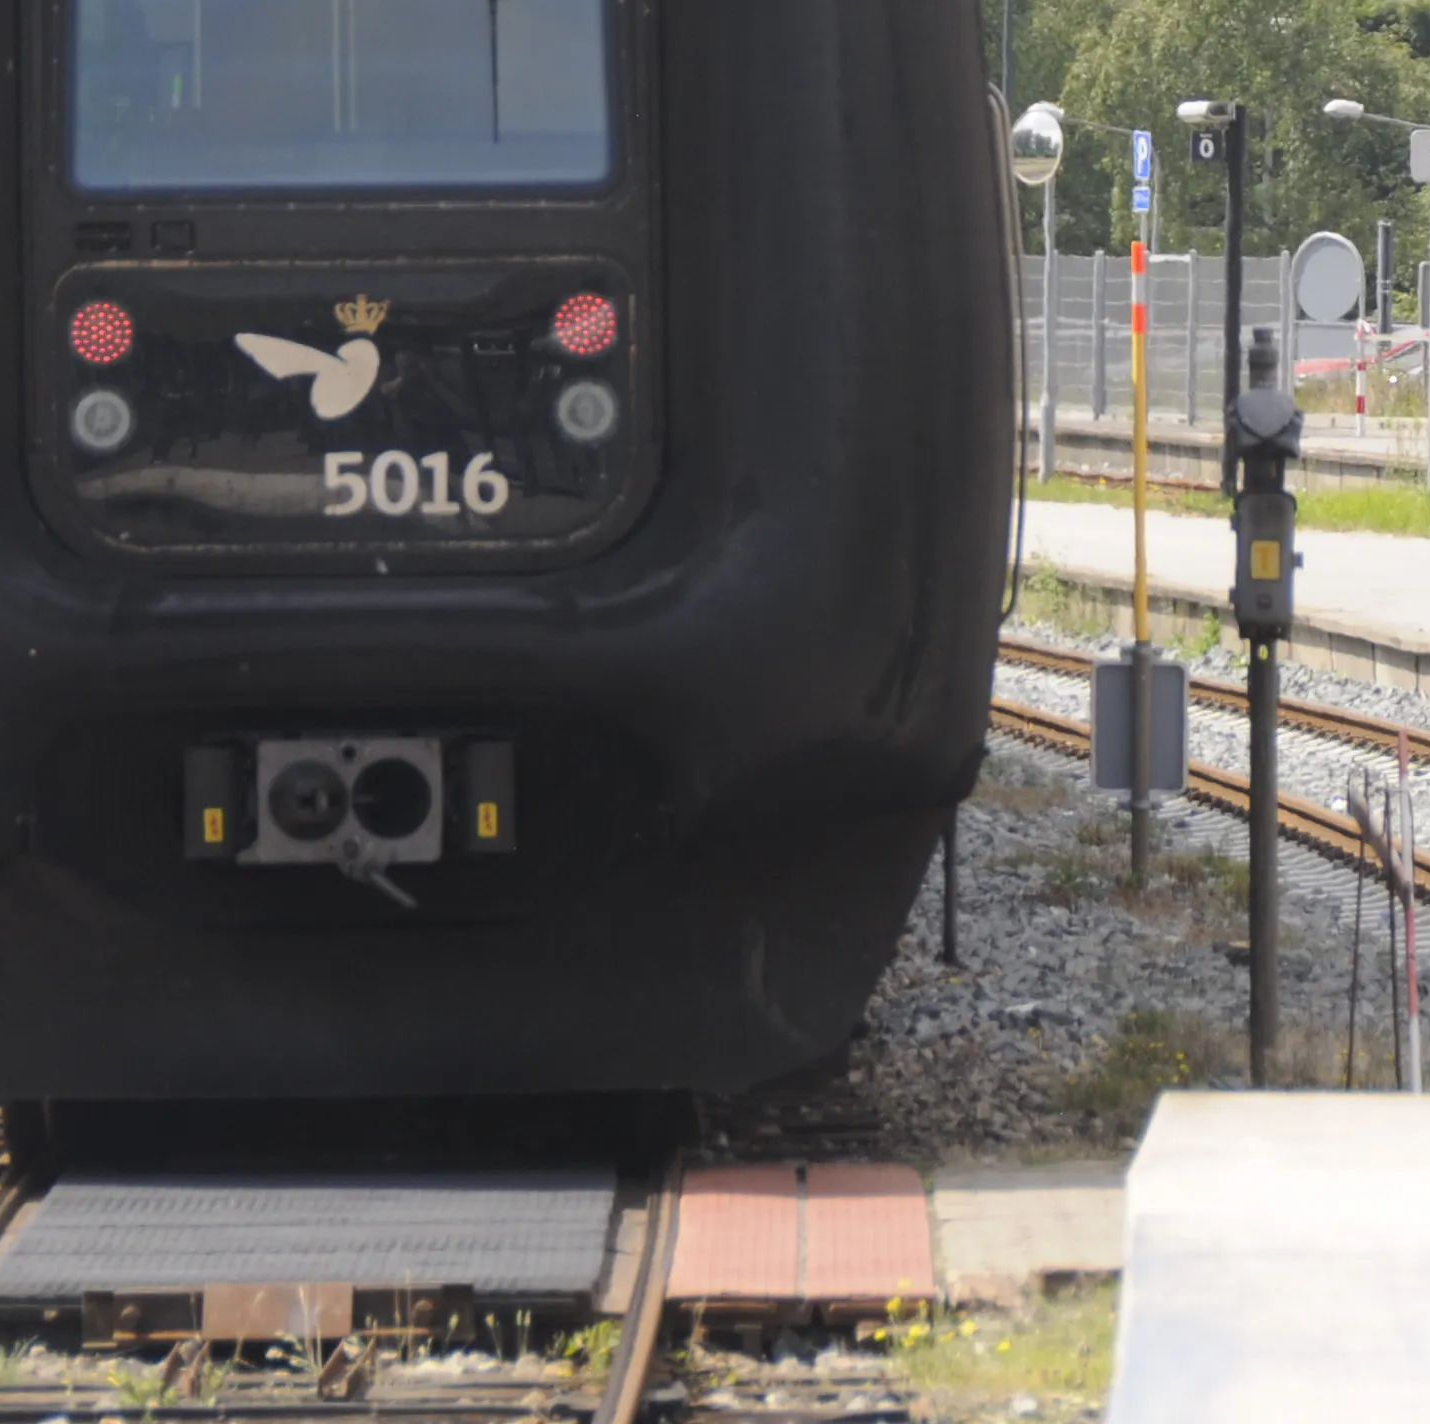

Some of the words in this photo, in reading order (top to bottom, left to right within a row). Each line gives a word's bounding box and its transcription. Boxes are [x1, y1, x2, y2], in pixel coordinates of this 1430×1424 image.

[1138, 137, 1148, 174] P
[1199, 139, 1214, 158] 0
[324, 450, 509, 515] 5016
